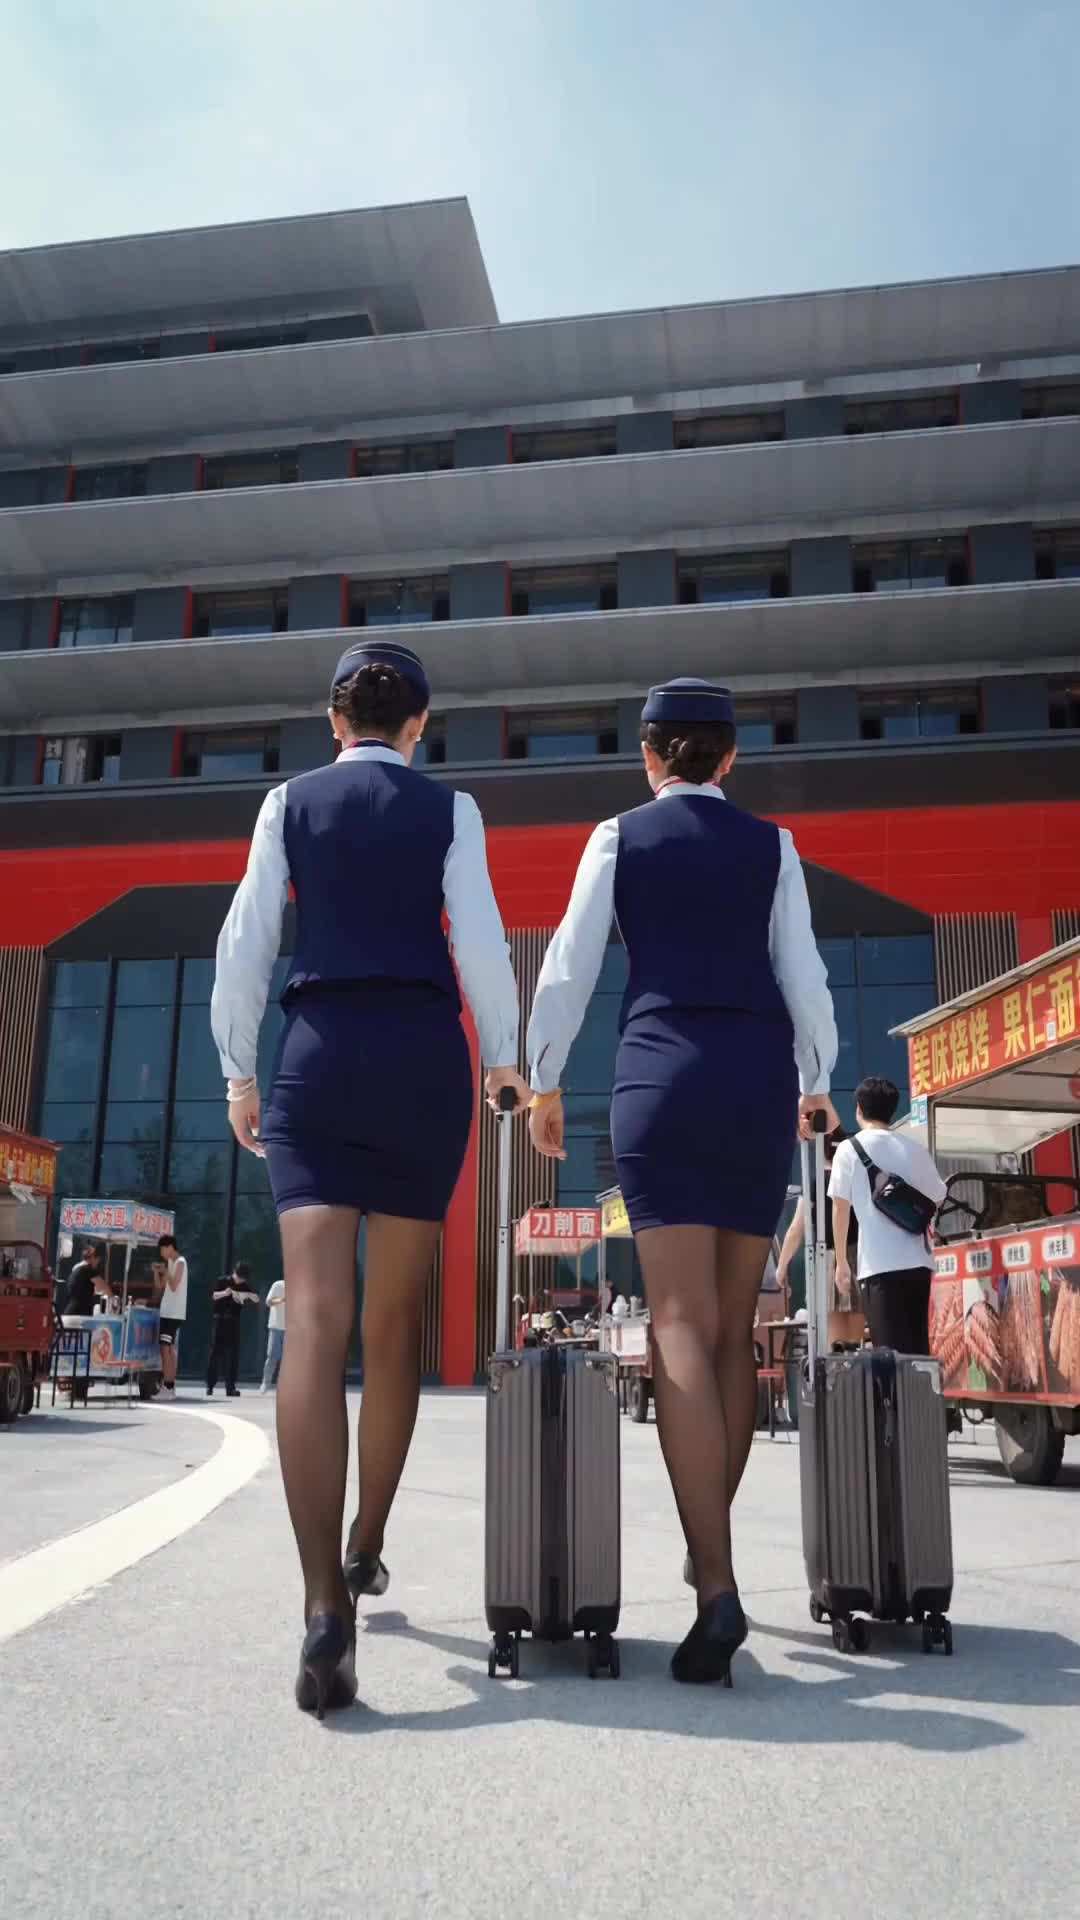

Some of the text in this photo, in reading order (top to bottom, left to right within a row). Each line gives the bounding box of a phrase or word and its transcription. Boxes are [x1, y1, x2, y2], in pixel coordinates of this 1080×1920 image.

[913, 958, 1080, 1094] 美味烧烤 果仁面
[63, 1205, 87, 1228] 冰粉
[531, 1211, 597, 1237] 刀削面
